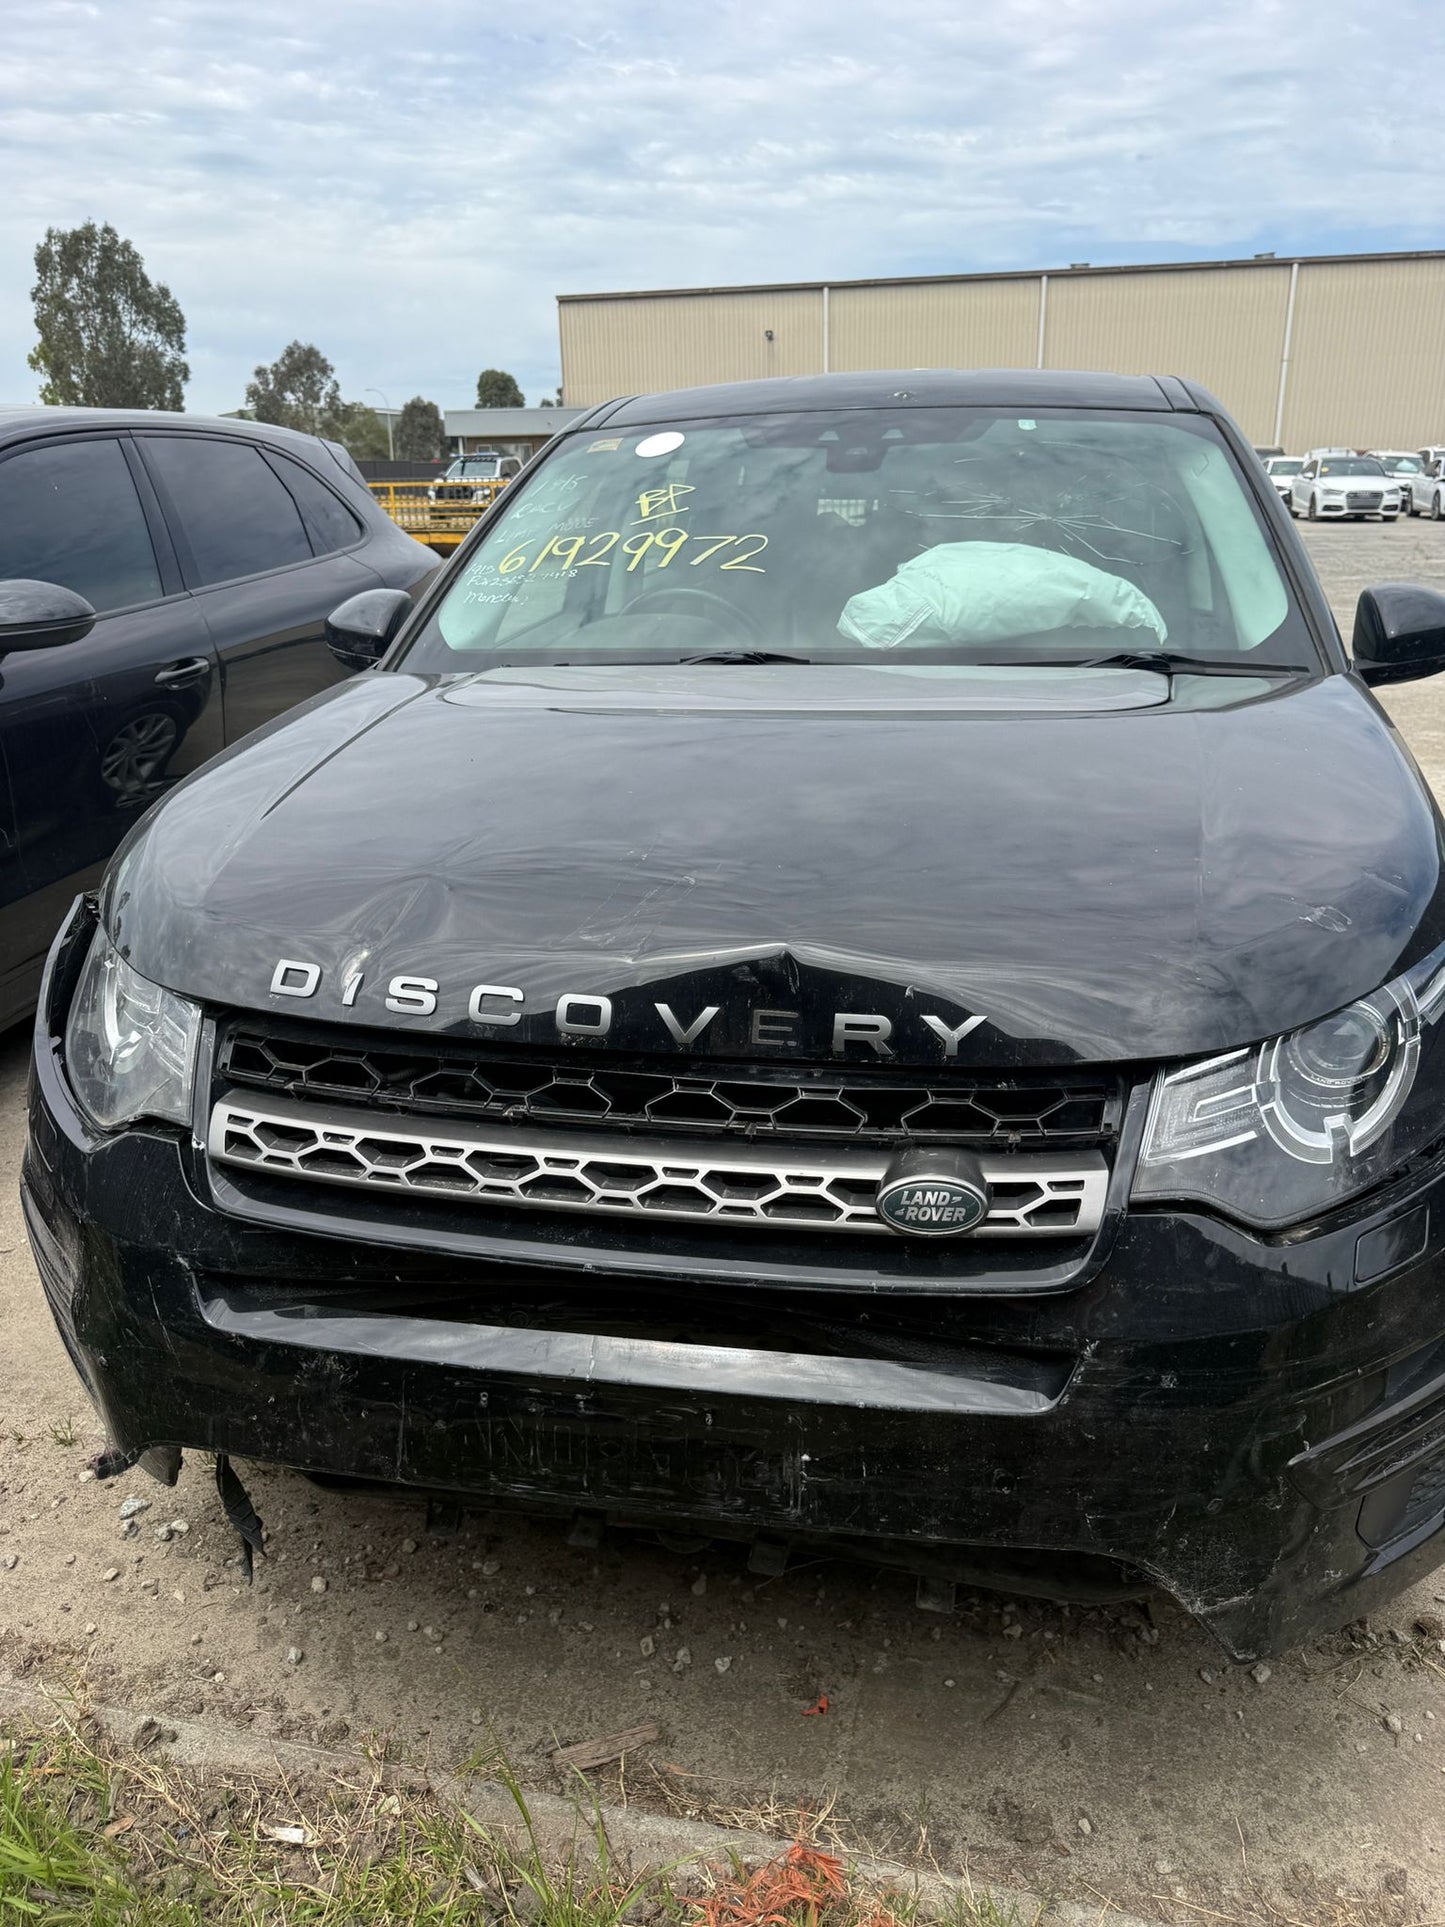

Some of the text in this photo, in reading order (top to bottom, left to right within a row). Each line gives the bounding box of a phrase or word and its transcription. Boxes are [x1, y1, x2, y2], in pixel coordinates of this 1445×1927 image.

[499, 528, 768, 574] 61929972
[270, 958, 988, 1056] DISCOVERY
[900, 1190, 950, 1206] LAND
[904, 1206, 966, 1222] ROVER
